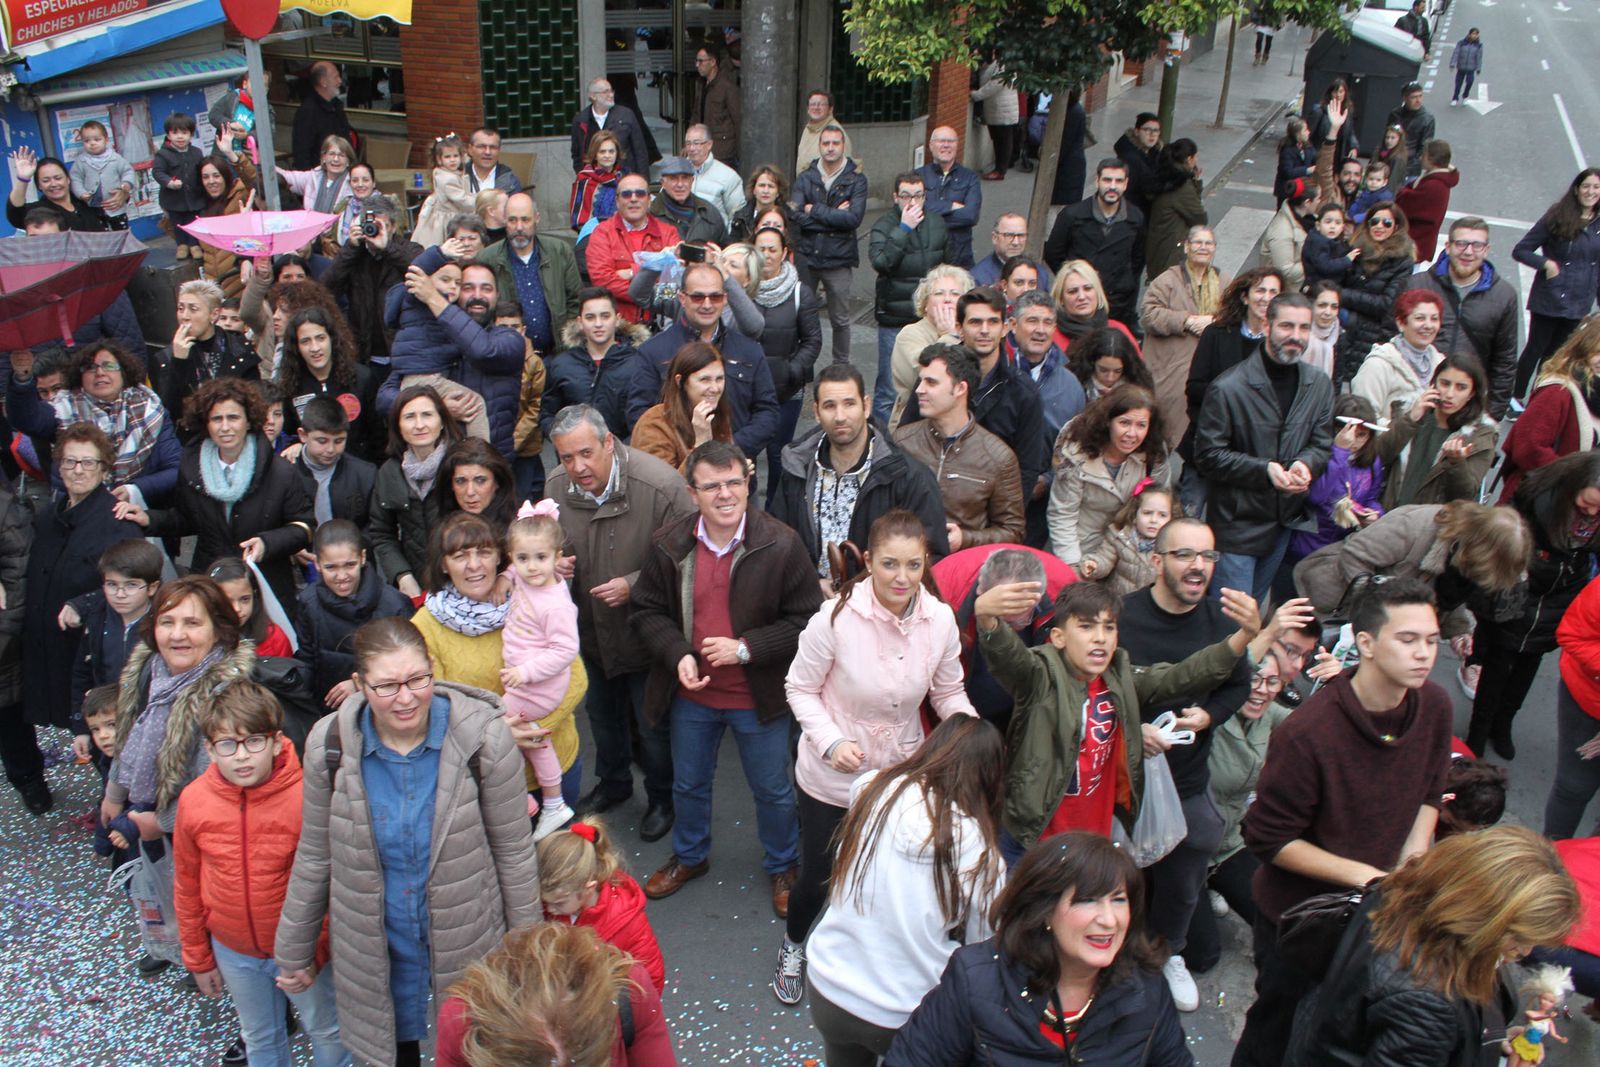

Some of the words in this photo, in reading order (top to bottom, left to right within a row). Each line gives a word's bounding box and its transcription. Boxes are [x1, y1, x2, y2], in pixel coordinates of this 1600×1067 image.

[16, 14, 75, 41] CHUCHES
[77, 12, 86, 24] Y
[87, 0, 139, 21] HELADOS
[25, 0, 95, 18] ESPECI
